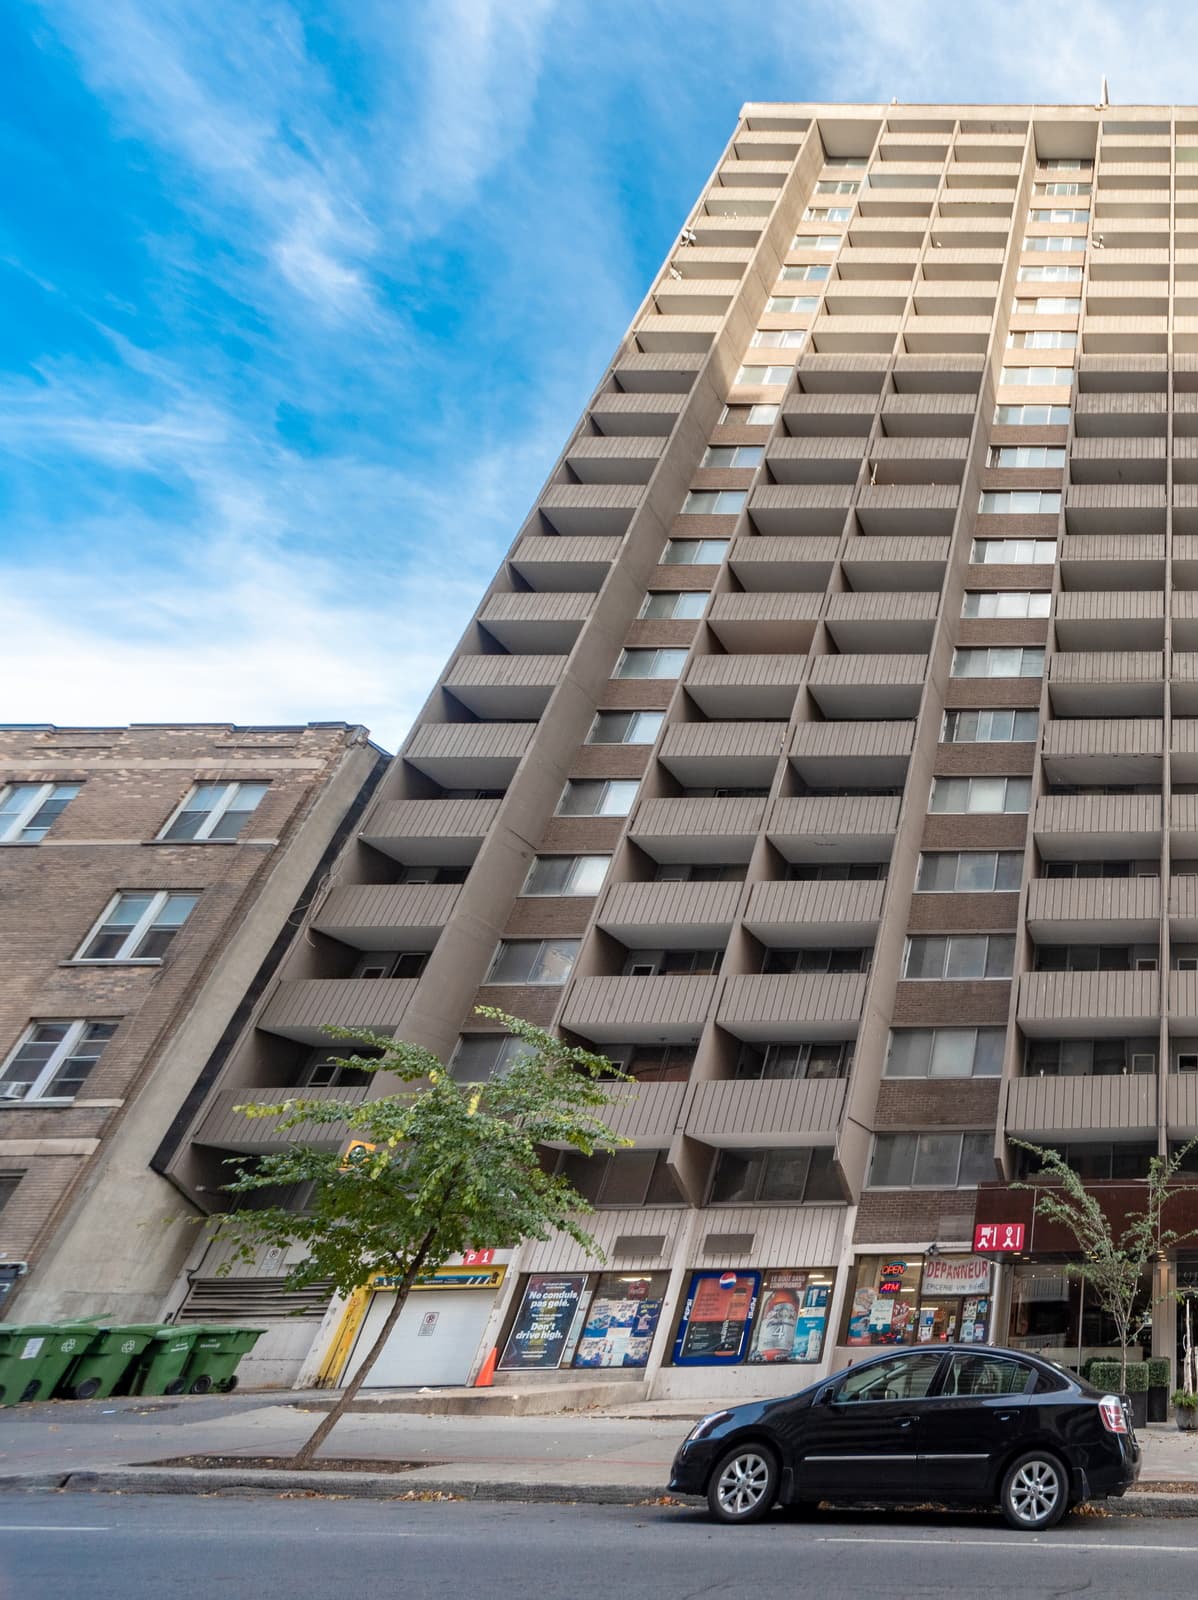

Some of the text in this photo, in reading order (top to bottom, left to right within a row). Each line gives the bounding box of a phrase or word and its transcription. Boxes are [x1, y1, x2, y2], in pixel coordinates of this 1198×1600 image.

[467, 1251, 490, 1263] P 1
[881, 1265, 904, 1275] OPEN
[927, 1260, 988, 1279] DEPANNEUR
[881, 1283, 899, 1291] ATM
[528, 1291, 542, 1299] Ne
[530, 1301, 547, 1309] pas
[684, 1299, 693, 1320] PEPSI
[748, 1297, 757, 1319] PEPSI
[531, 1322, 556, 1331] Don't
[516, 1330, 563, 1340] drive high.
